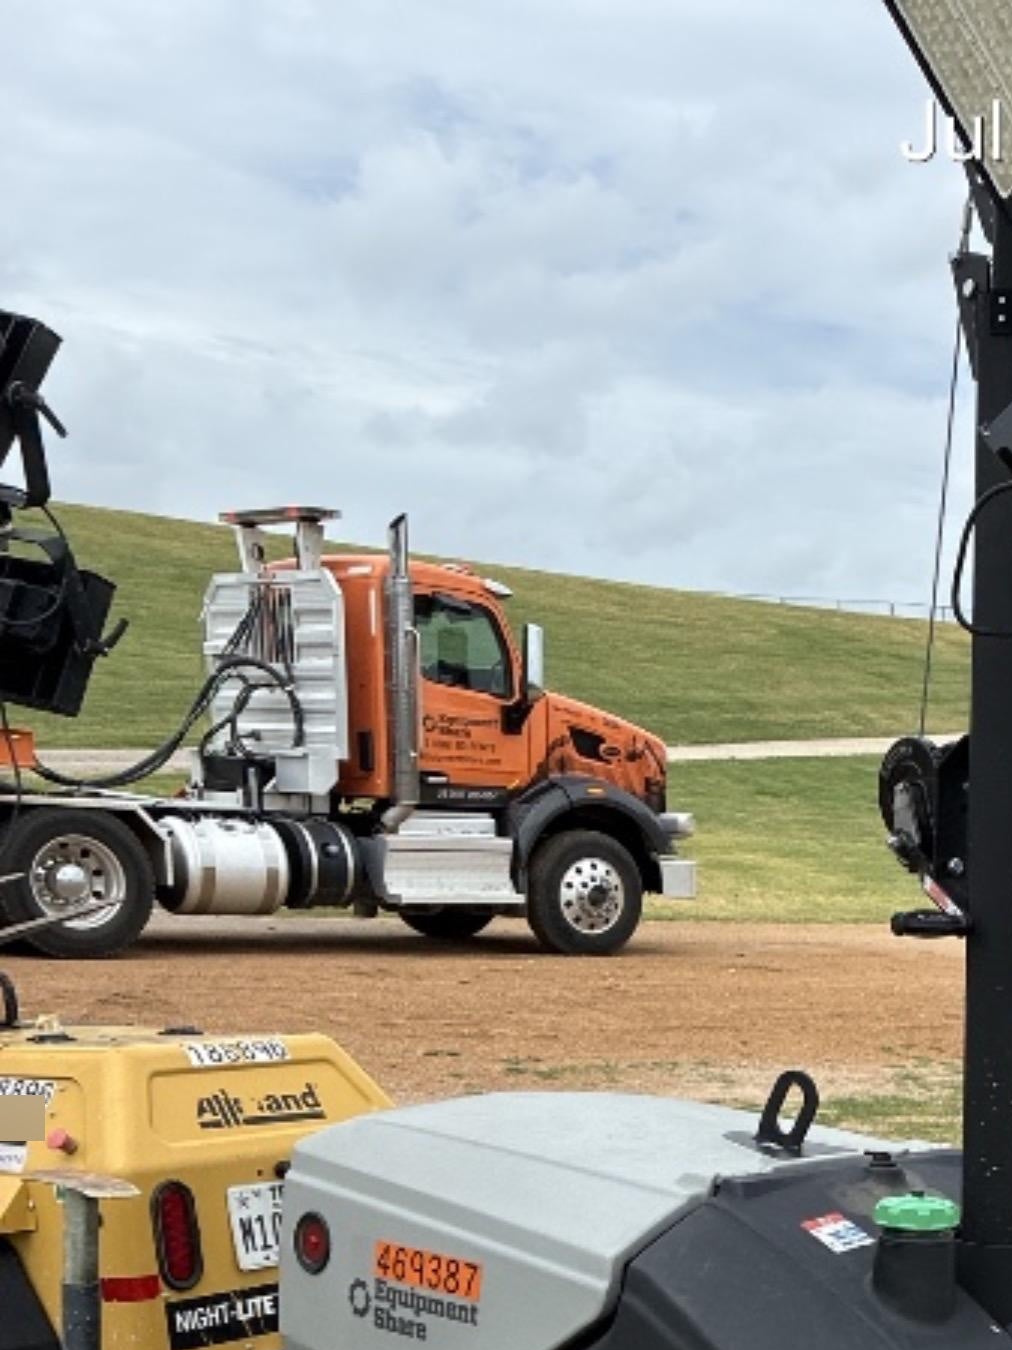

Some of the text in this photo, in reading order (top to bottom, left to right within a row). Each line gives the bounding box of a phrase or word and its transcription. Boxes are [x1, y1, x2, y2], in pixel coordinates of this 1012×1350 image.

[376, 1245, 478, 1296] 469387
[175, 1294, 277, 1334] NIGHT-LITE
[373, 1277, 479, 1327] Equipment
[373, 1306, 427, 1341] Share
